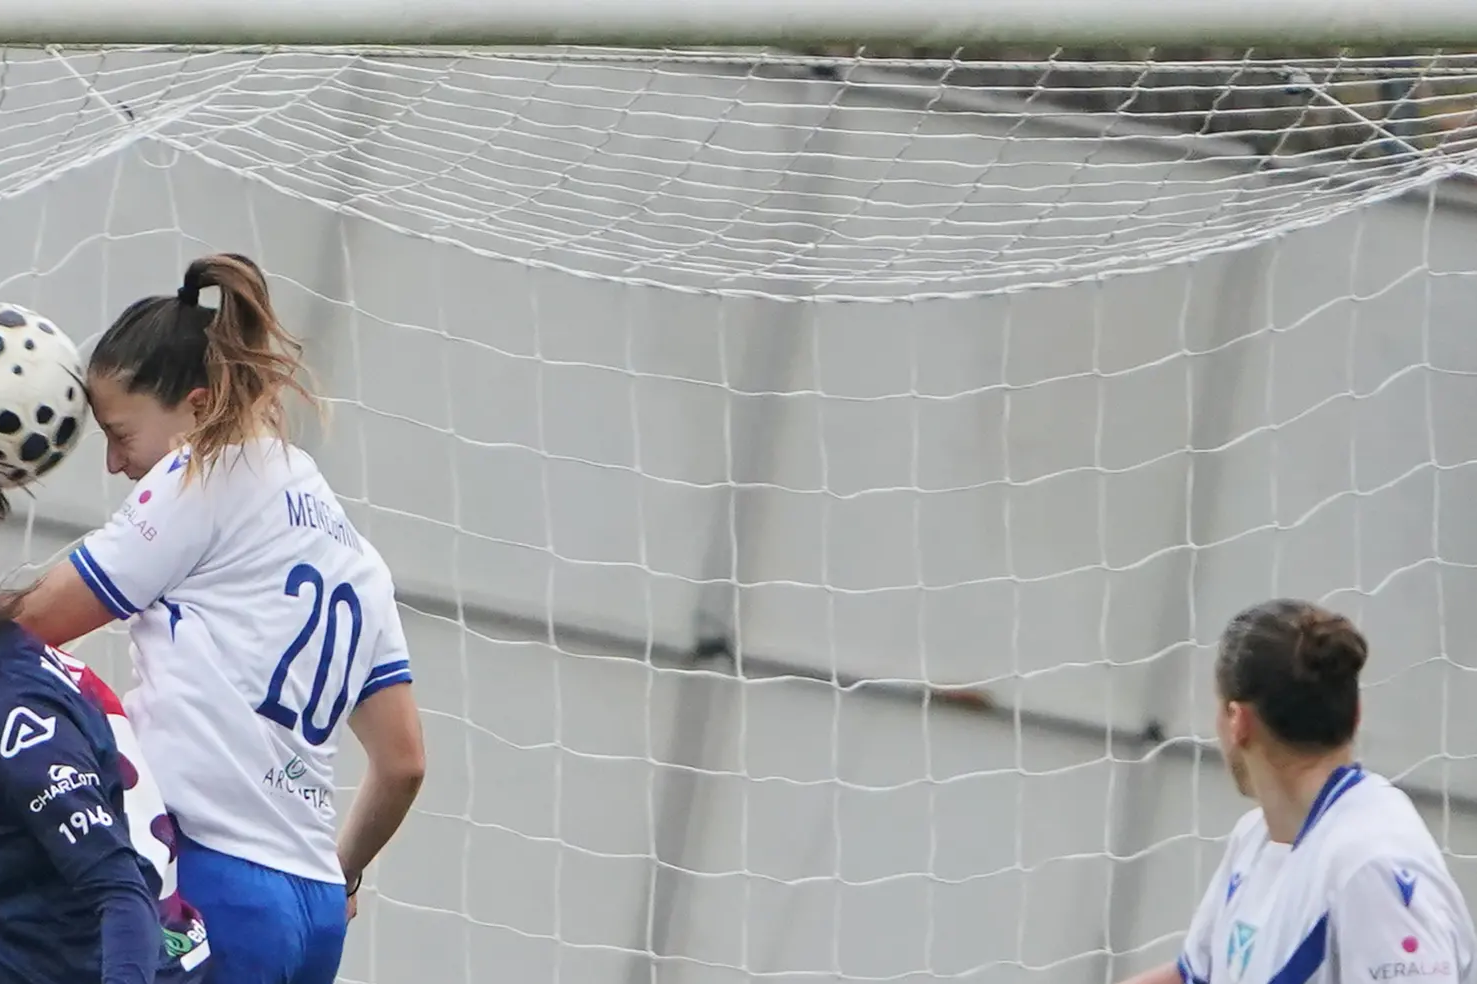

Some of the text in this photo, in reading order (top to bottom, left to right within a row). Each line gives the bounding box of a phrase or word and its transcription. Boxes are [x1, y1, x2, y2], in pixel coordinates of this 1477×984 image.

[256, 563, 364, 746] 20
[58, 804, 114, 845] 1946
[1368, 961, 1451, 981] VERALAB
